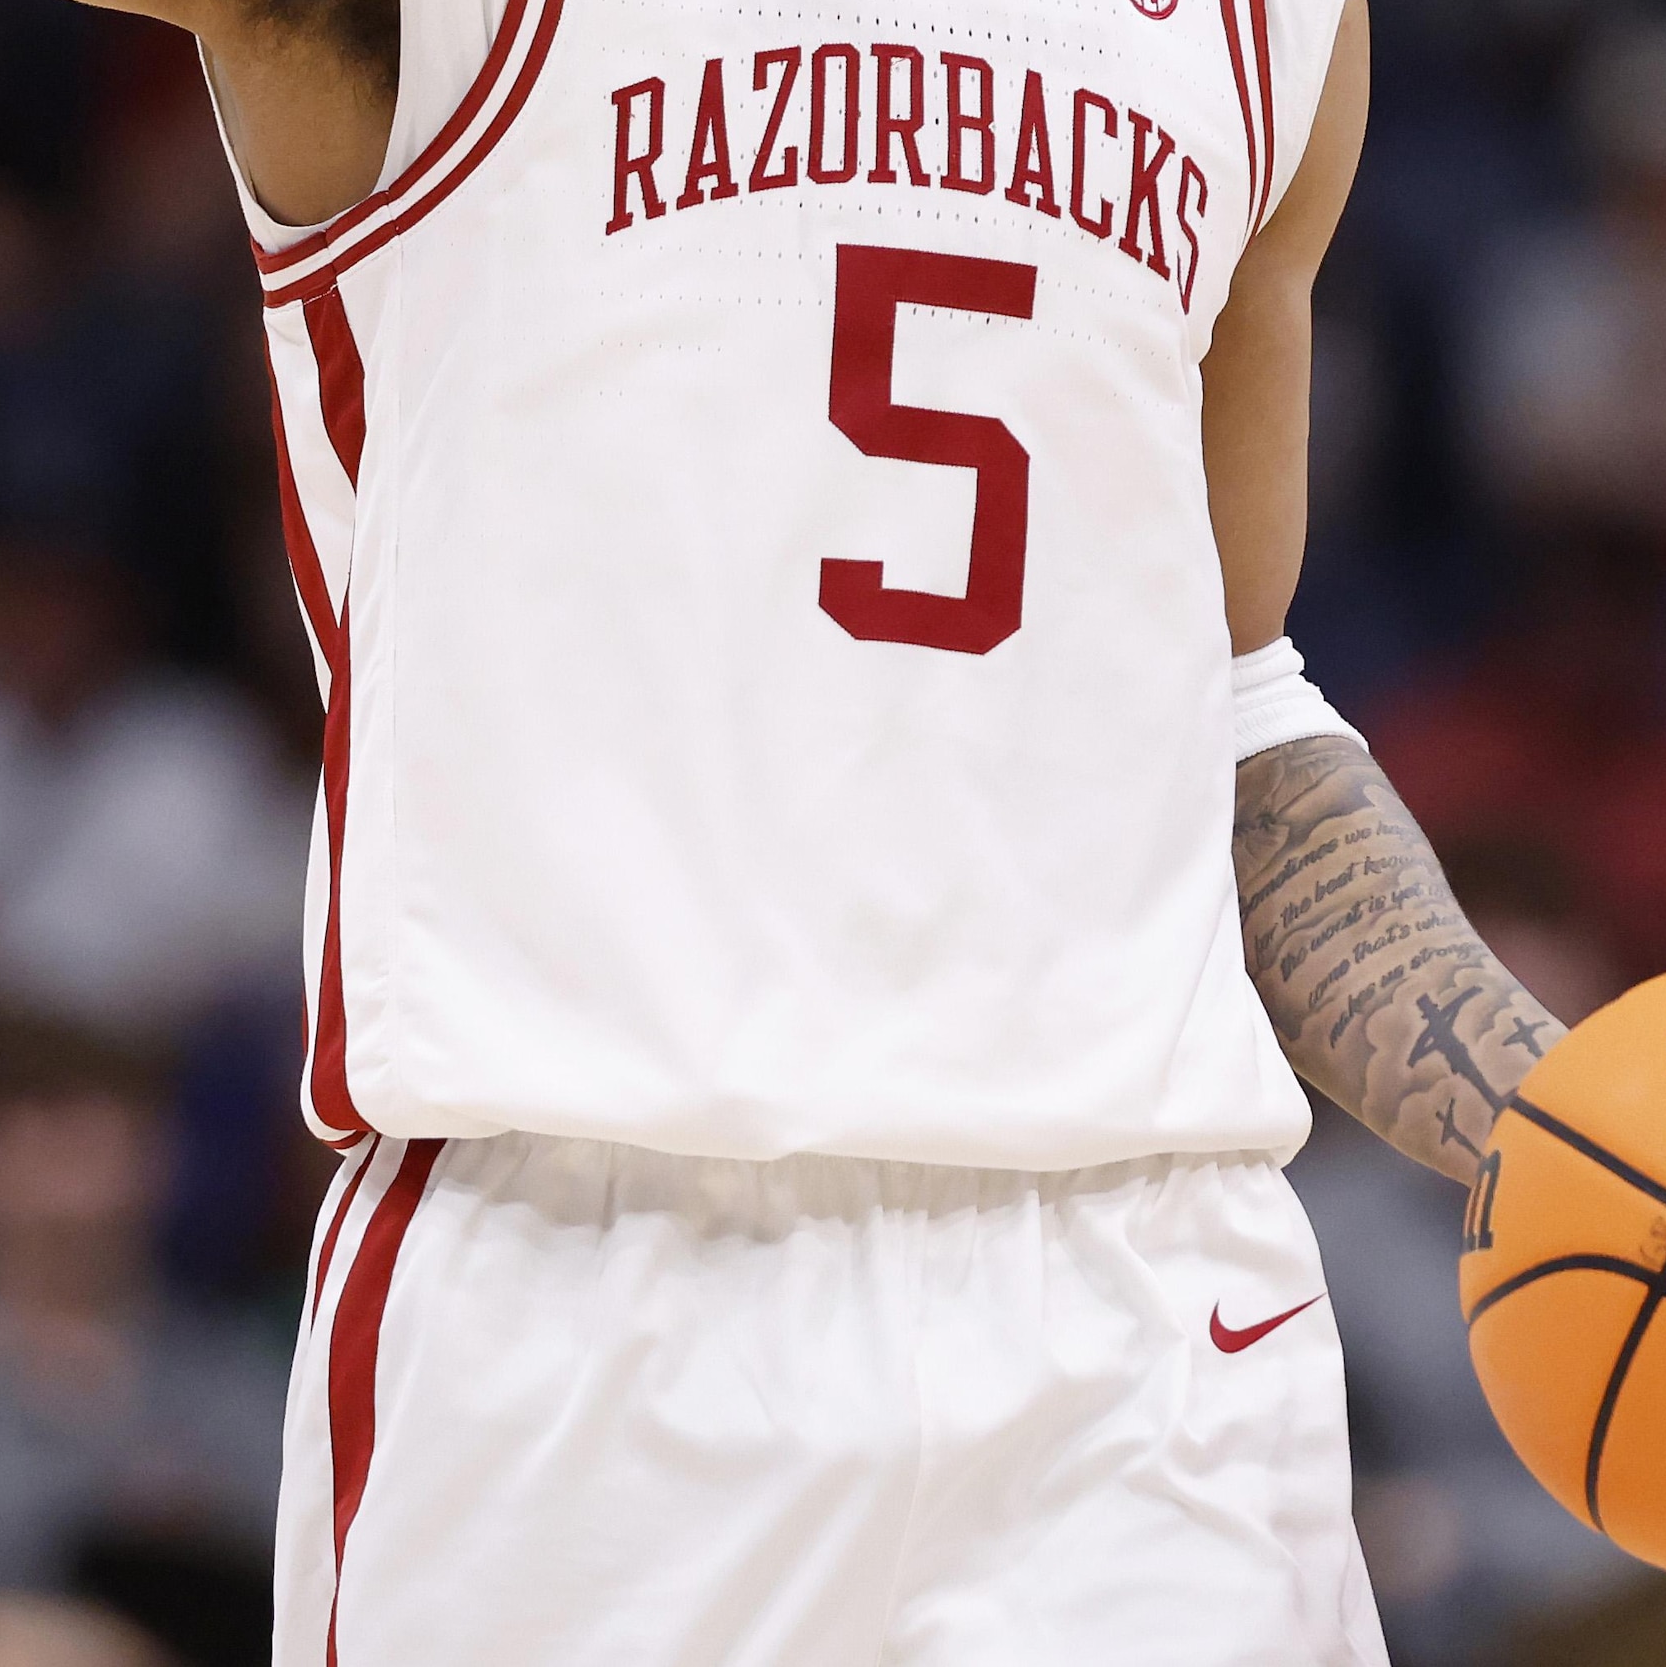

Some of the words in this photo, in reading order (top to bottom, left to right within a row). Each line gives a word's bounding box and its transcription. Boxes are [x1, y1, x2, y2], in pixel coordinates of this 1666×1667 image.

[605, 43, 1208, 315] RAZORBACKS
[818, 243, 1038, 655] 5
[1281, 896, 1312, 928] the
[1315, 862, 1364, 903] best
[1311, 899, 1366, 952] worst
